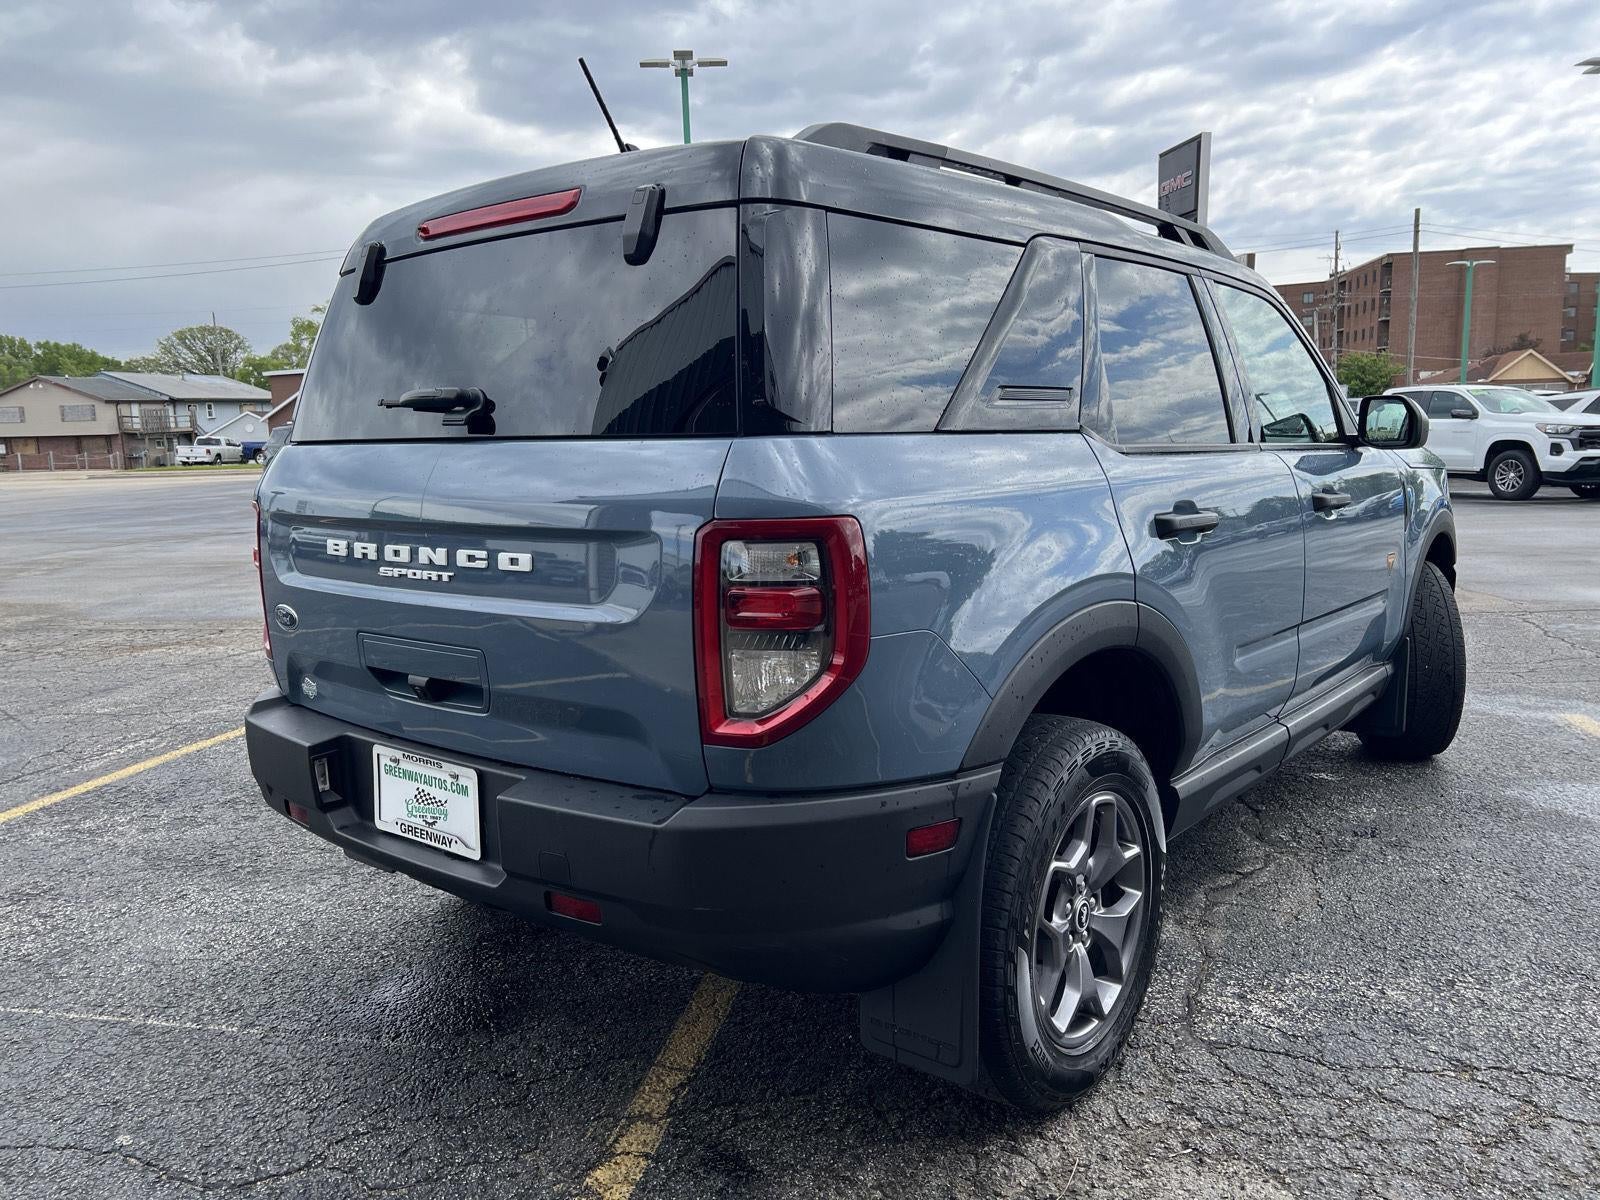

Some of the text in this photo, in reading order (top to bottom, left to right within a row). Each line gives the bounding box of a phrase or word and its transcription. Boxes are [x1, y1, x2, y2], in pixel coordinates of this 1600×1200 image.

[1160, 170, 1192, 197] GMC
[326, 539, 533, 572] BRONCO
[378, 566, 455, 582] SPORT
[402, 753, 443, 769] MORRIS
[383, 763, 469, 797] GREENWAYAUTOS.COM
[405, 798, 449, 821] Greenway
[399, 821, 453, 848] GREENWAY
